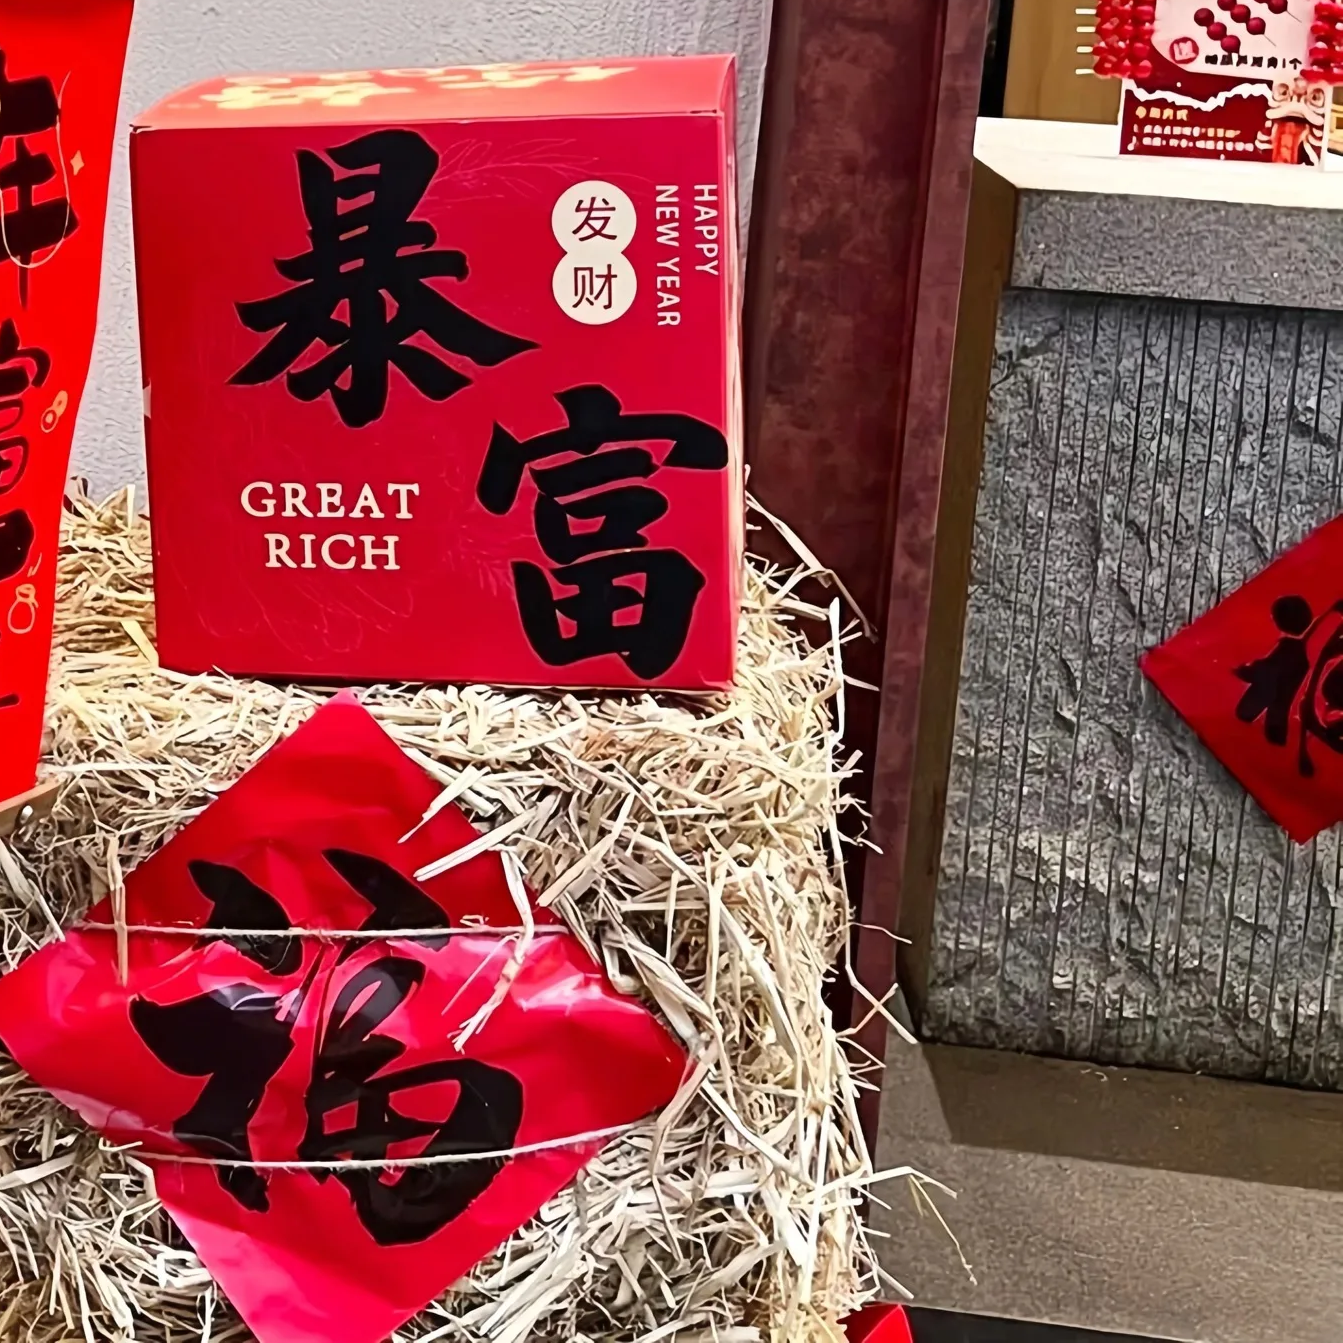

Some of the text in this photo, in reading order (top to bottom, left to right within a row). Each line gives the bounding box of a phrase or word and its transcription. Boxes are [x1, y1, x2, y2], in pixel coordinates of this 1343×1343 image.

[571, 195, 619, 311] 发财
[654, 183, 682, 327] NEW YEAR
[692, 183, 720, 277] HAPPY
[239, 480, 421, 520] GREAT
[263, 532, 401, 571] RICH
[128, 846, 526, 1247] 福
